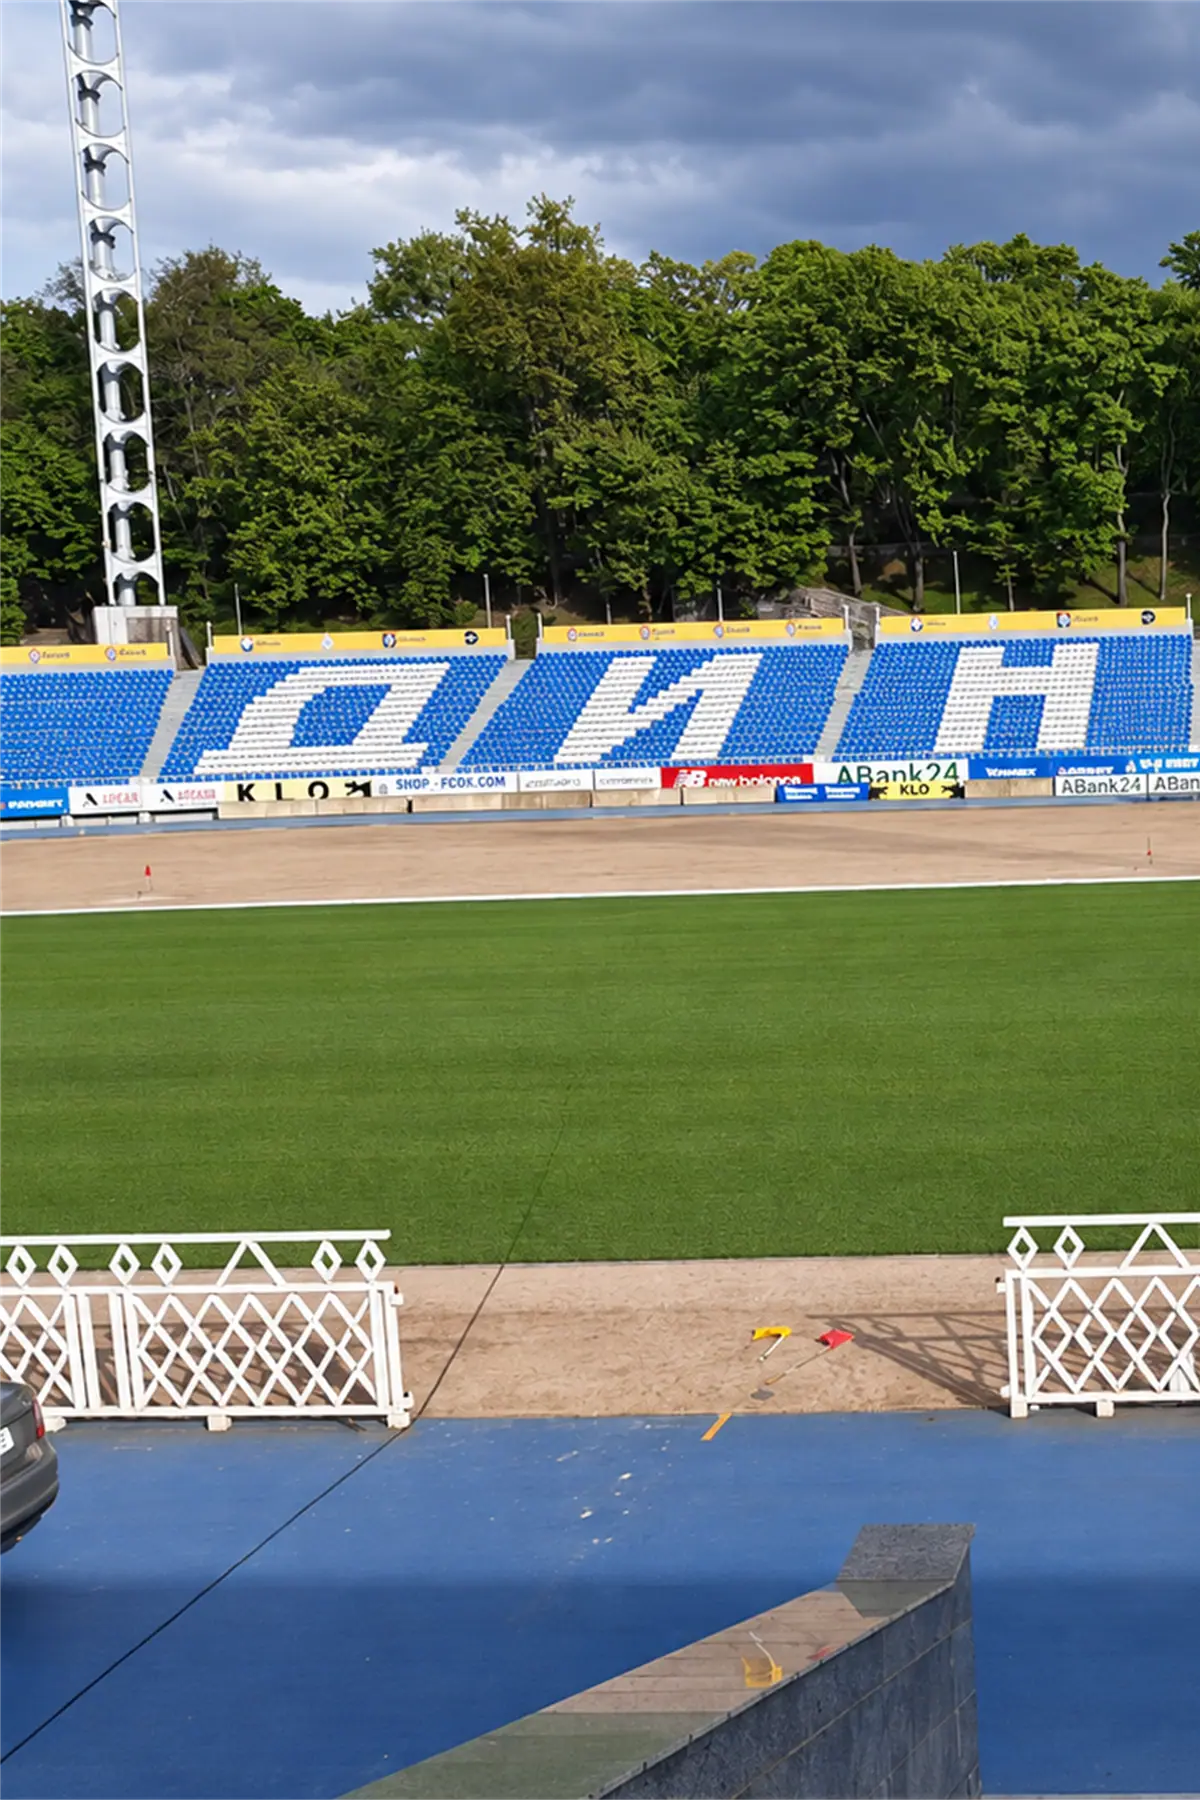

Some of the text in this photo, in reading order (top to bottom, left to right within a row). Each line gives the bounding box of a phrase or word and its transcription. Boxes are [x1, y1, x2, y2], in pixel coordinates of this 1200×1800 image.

[836, 761, 960, 785] ABank24
[237, 780, 330, 802] KLO
[396, 778, 430, 790] SHOP
[900, 783, 930, 796] KLO
[1061, 776, 1141, 795] ABank24
